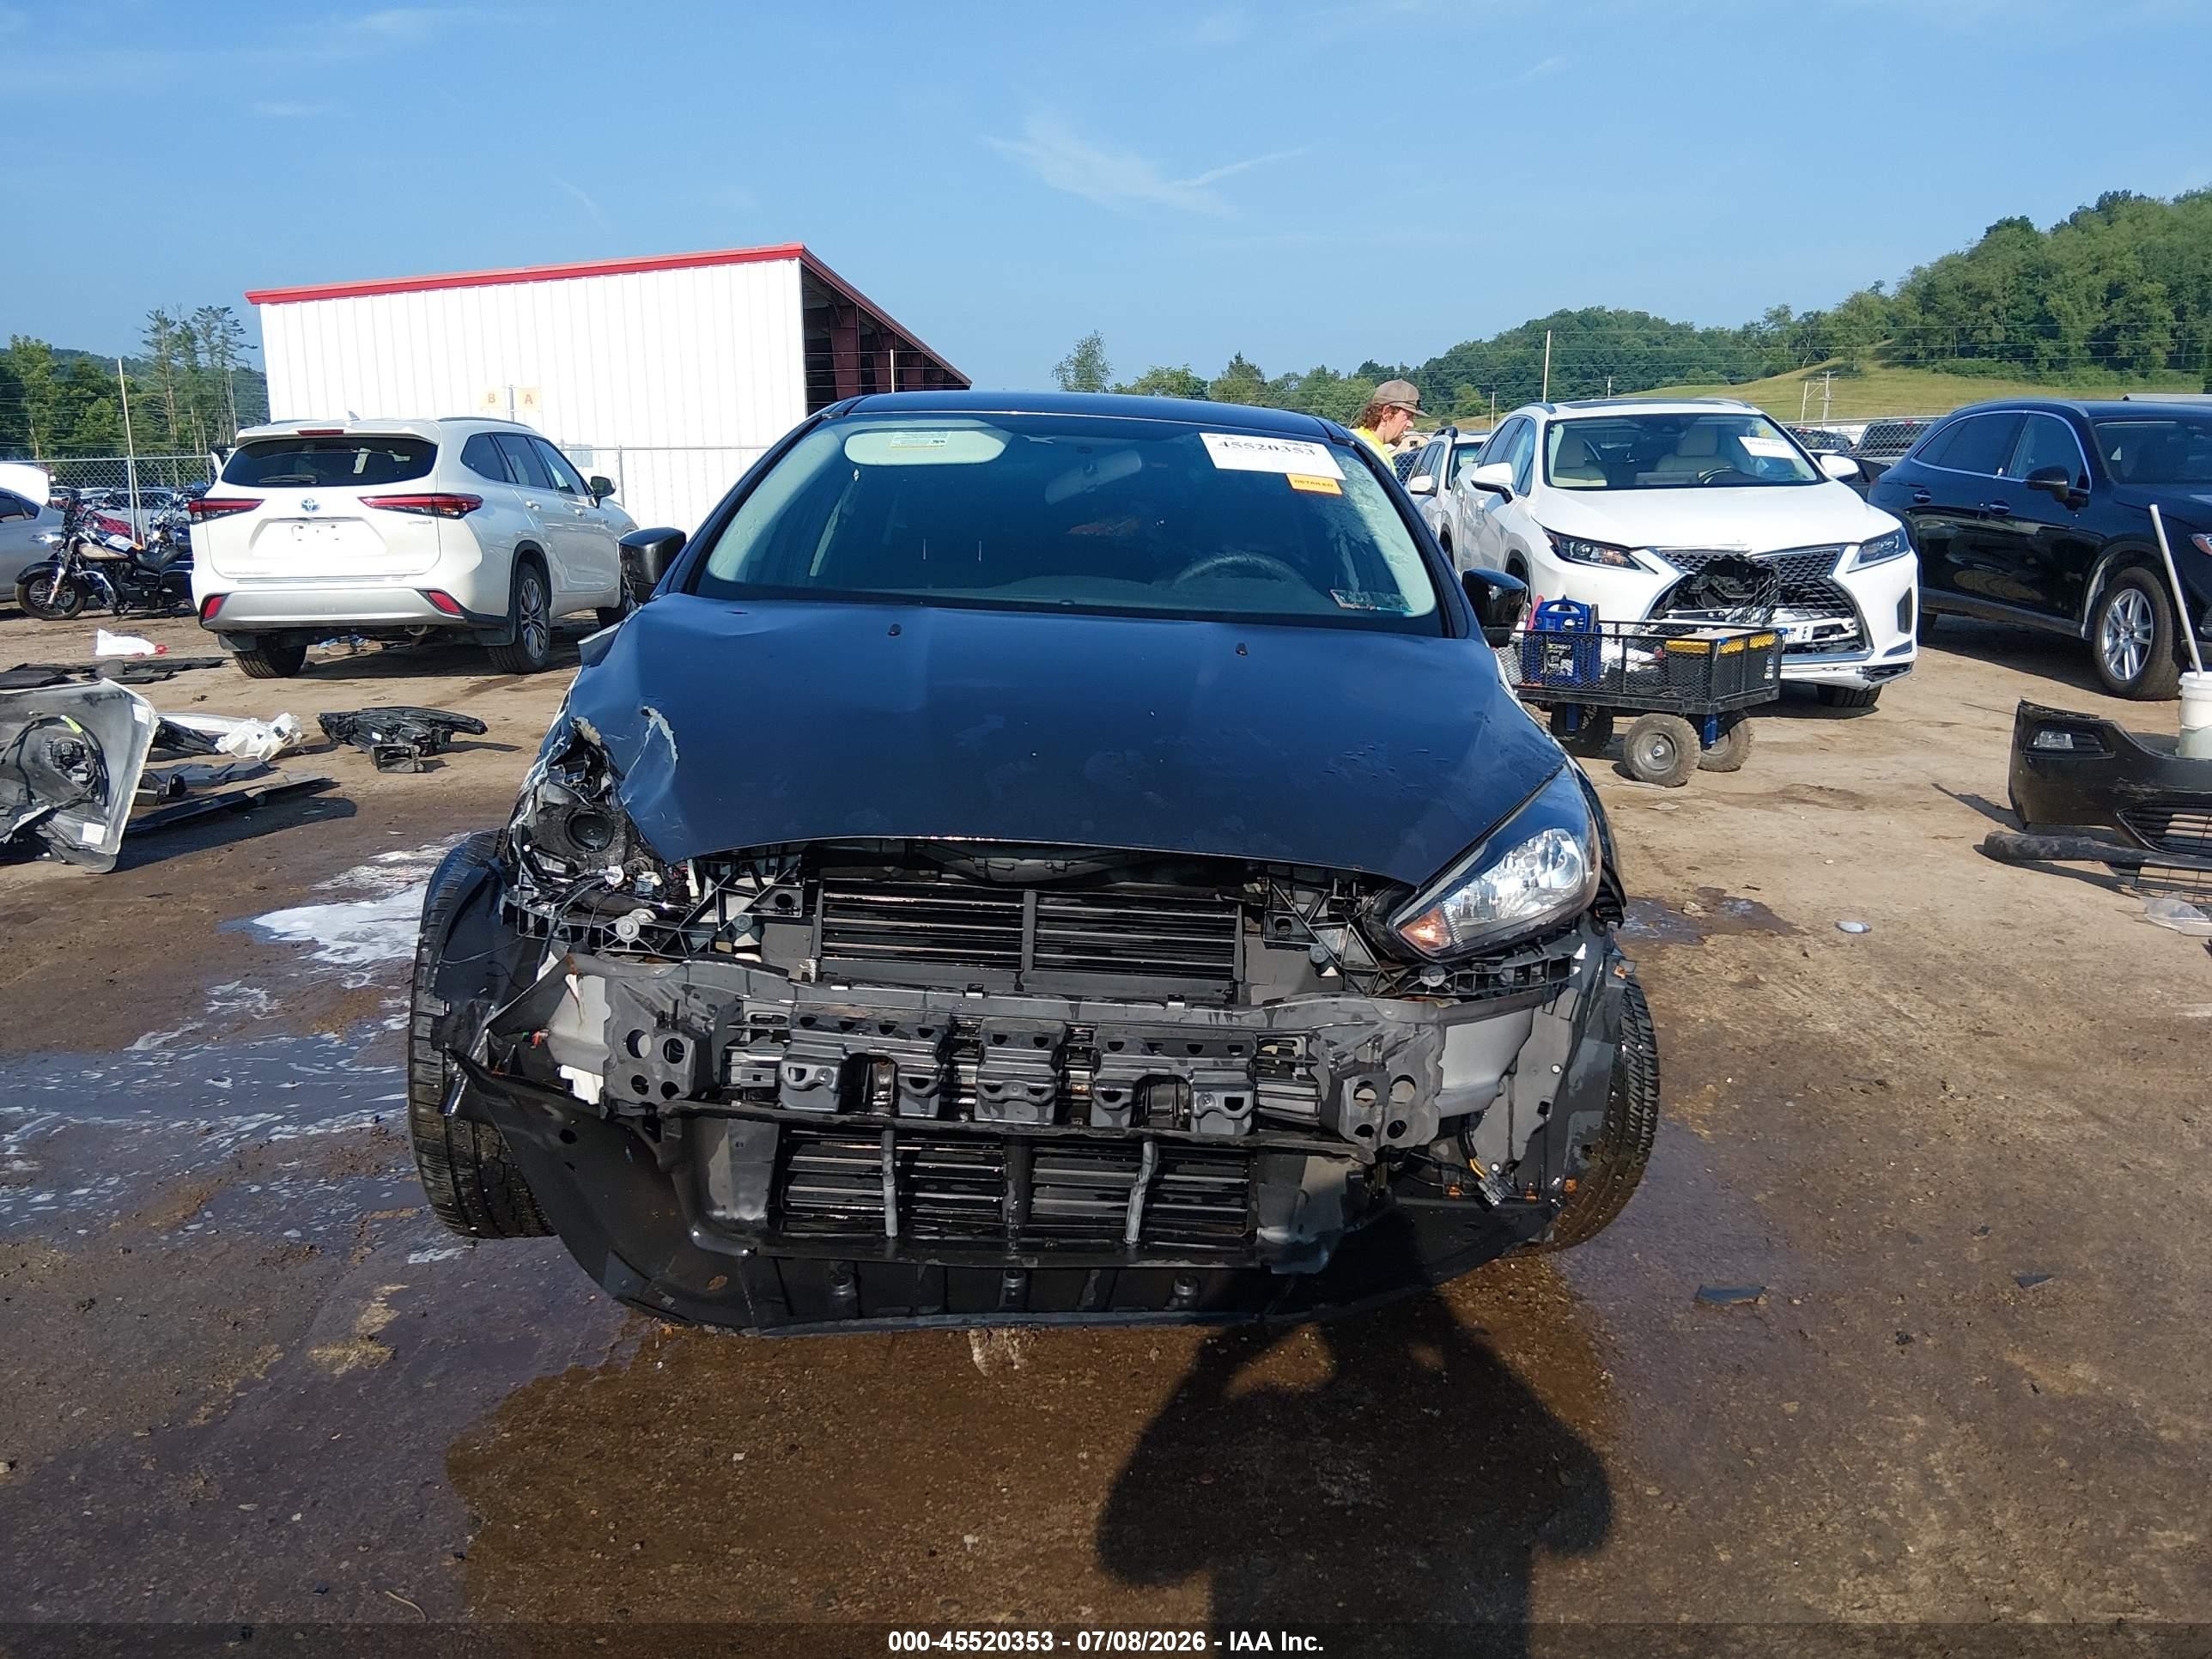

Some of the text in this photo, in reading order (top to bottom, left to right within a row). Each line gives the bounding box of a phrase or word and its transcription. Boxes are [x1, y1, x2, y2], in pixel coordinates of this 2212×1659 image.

[488, 392, 495, 404] B
[525, 393, 533, 404] A
[1218, 441, 1316, 456] 45520353
